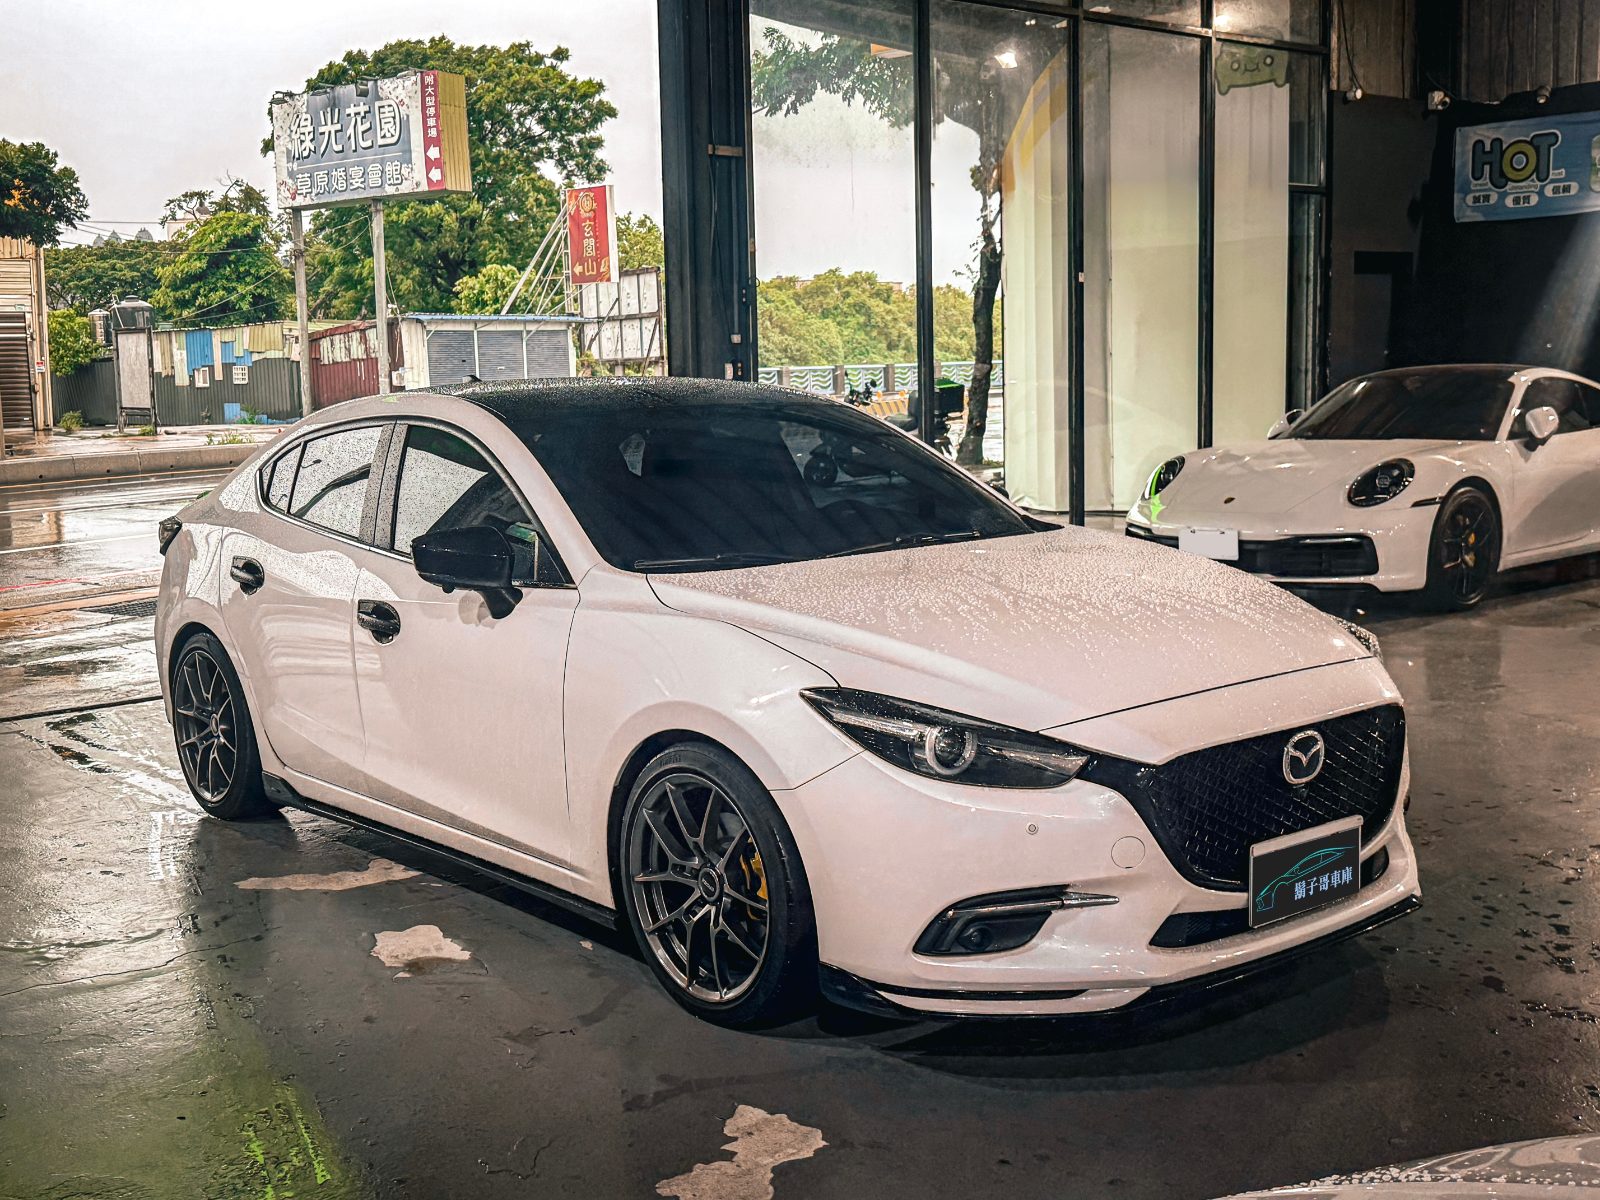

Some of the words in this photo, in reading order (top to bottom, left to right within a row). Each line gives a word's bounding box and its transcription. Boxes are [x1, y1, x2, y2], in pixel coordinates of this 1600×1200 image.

[291, 101, 401, 160] 綠光花園
[423, 75, 438, 138] 附大型停車場
[296, 161, 402, 195] 草原婚宴會館
[1471, 130, 1560, 190] HOT
